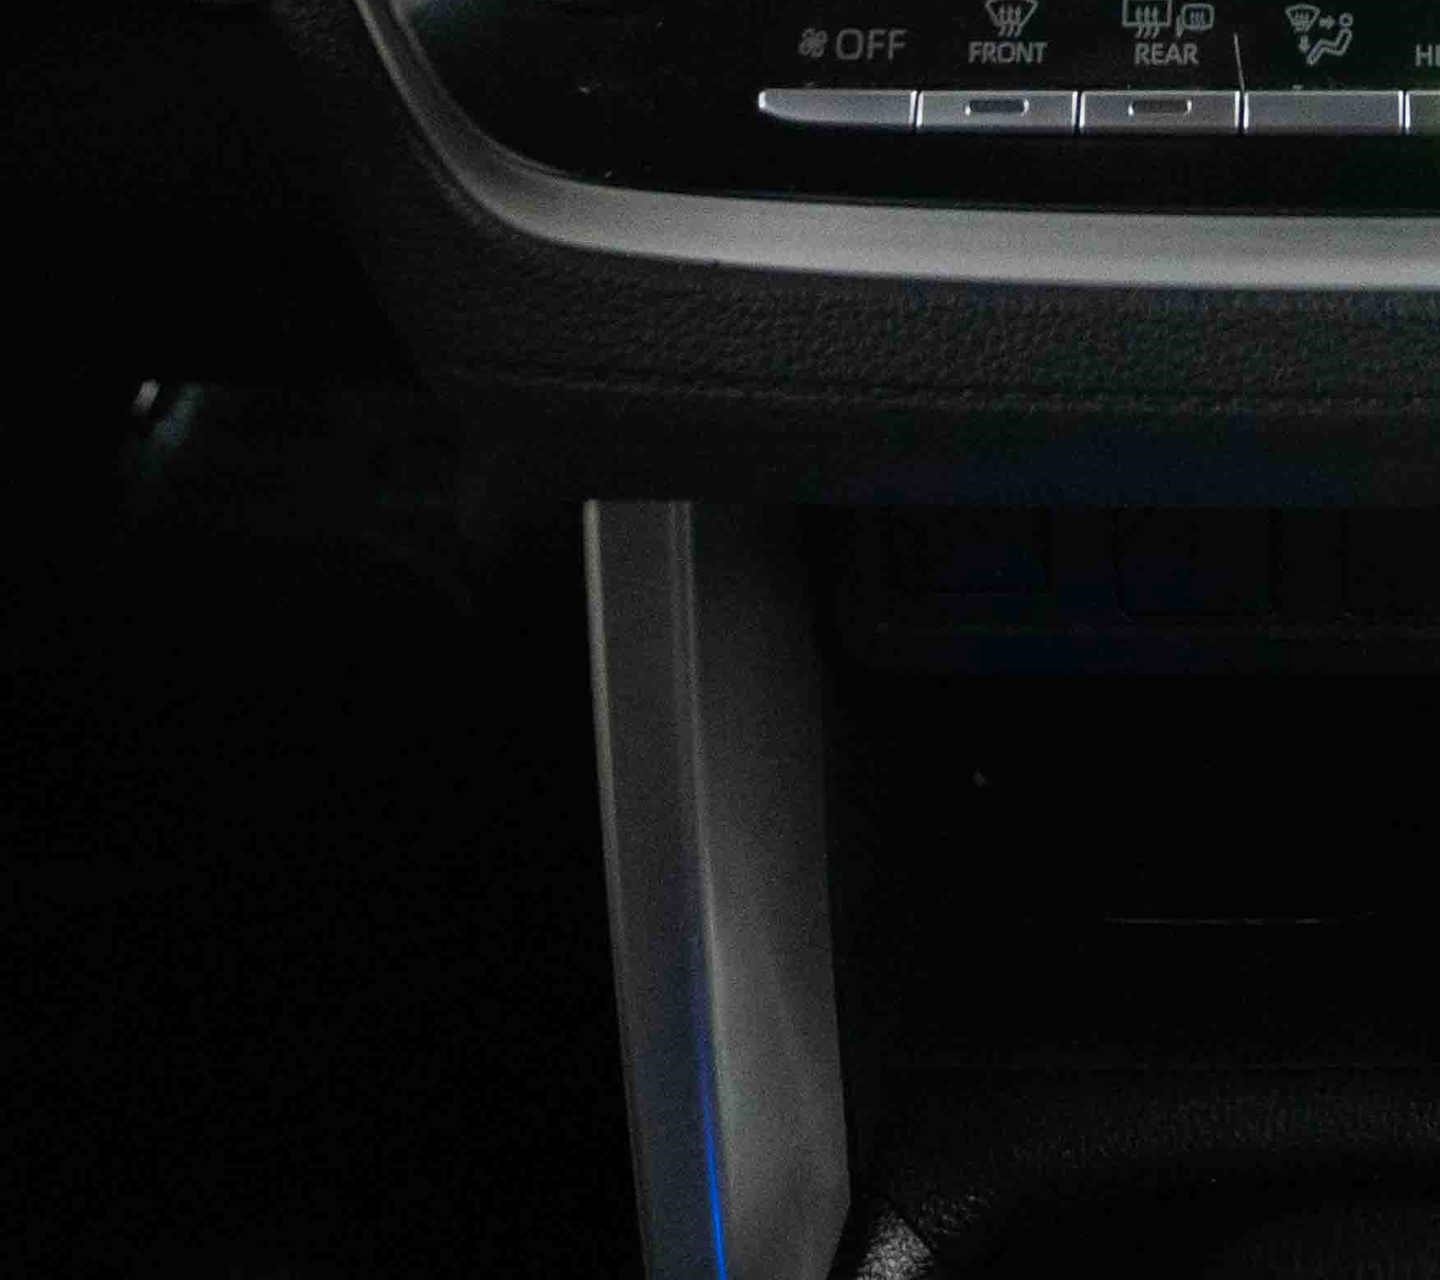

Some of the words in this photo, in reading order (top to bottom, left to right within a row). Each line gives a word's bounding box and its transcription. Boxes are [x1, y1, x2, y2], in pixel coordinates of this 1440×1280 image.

[834, 28, 908, 60] OFF
[967, 41, 1049, 65] FRONT
[1133, 42, 1200, 66] REAR
